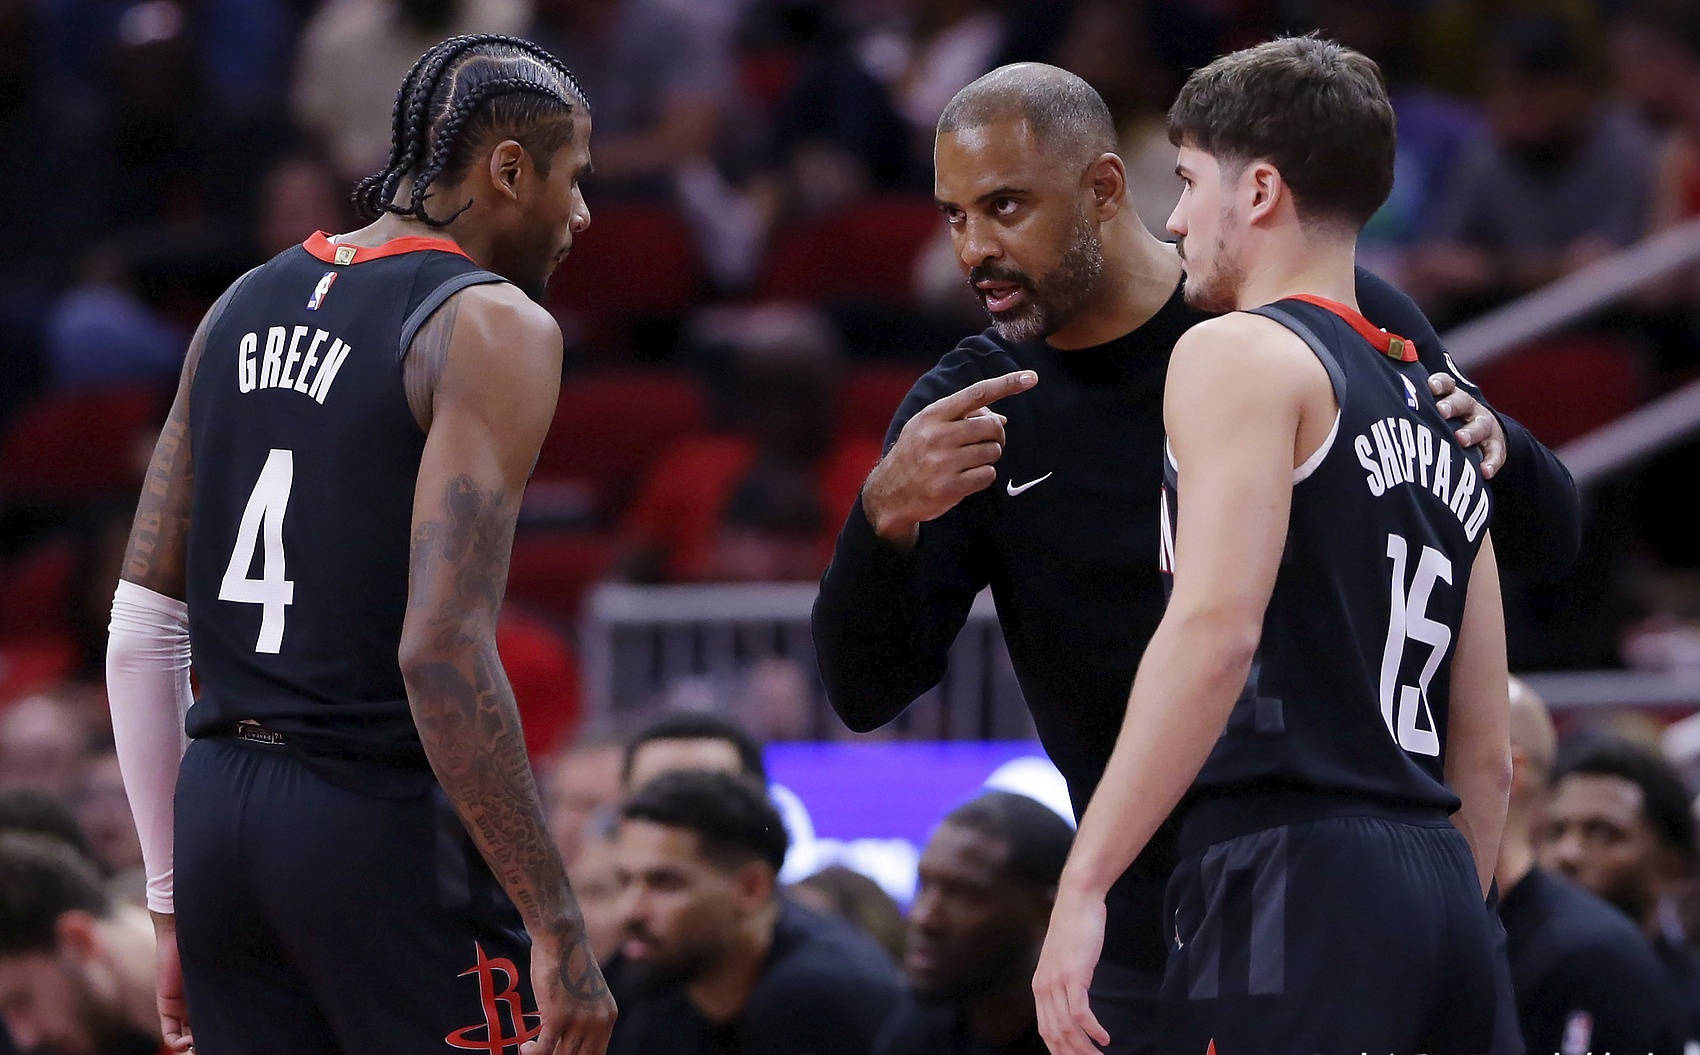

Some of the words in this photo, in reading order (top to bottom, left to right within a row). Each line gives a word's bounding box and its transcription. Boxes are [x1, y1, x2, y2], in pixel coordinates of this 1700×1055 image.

[238, 325, 351, 405] GREEN
[218, 448, 294, 654] 4
[1354, 417, 1490, 544] SHEPPARD
[1379, 533, 1453, 757] 15
